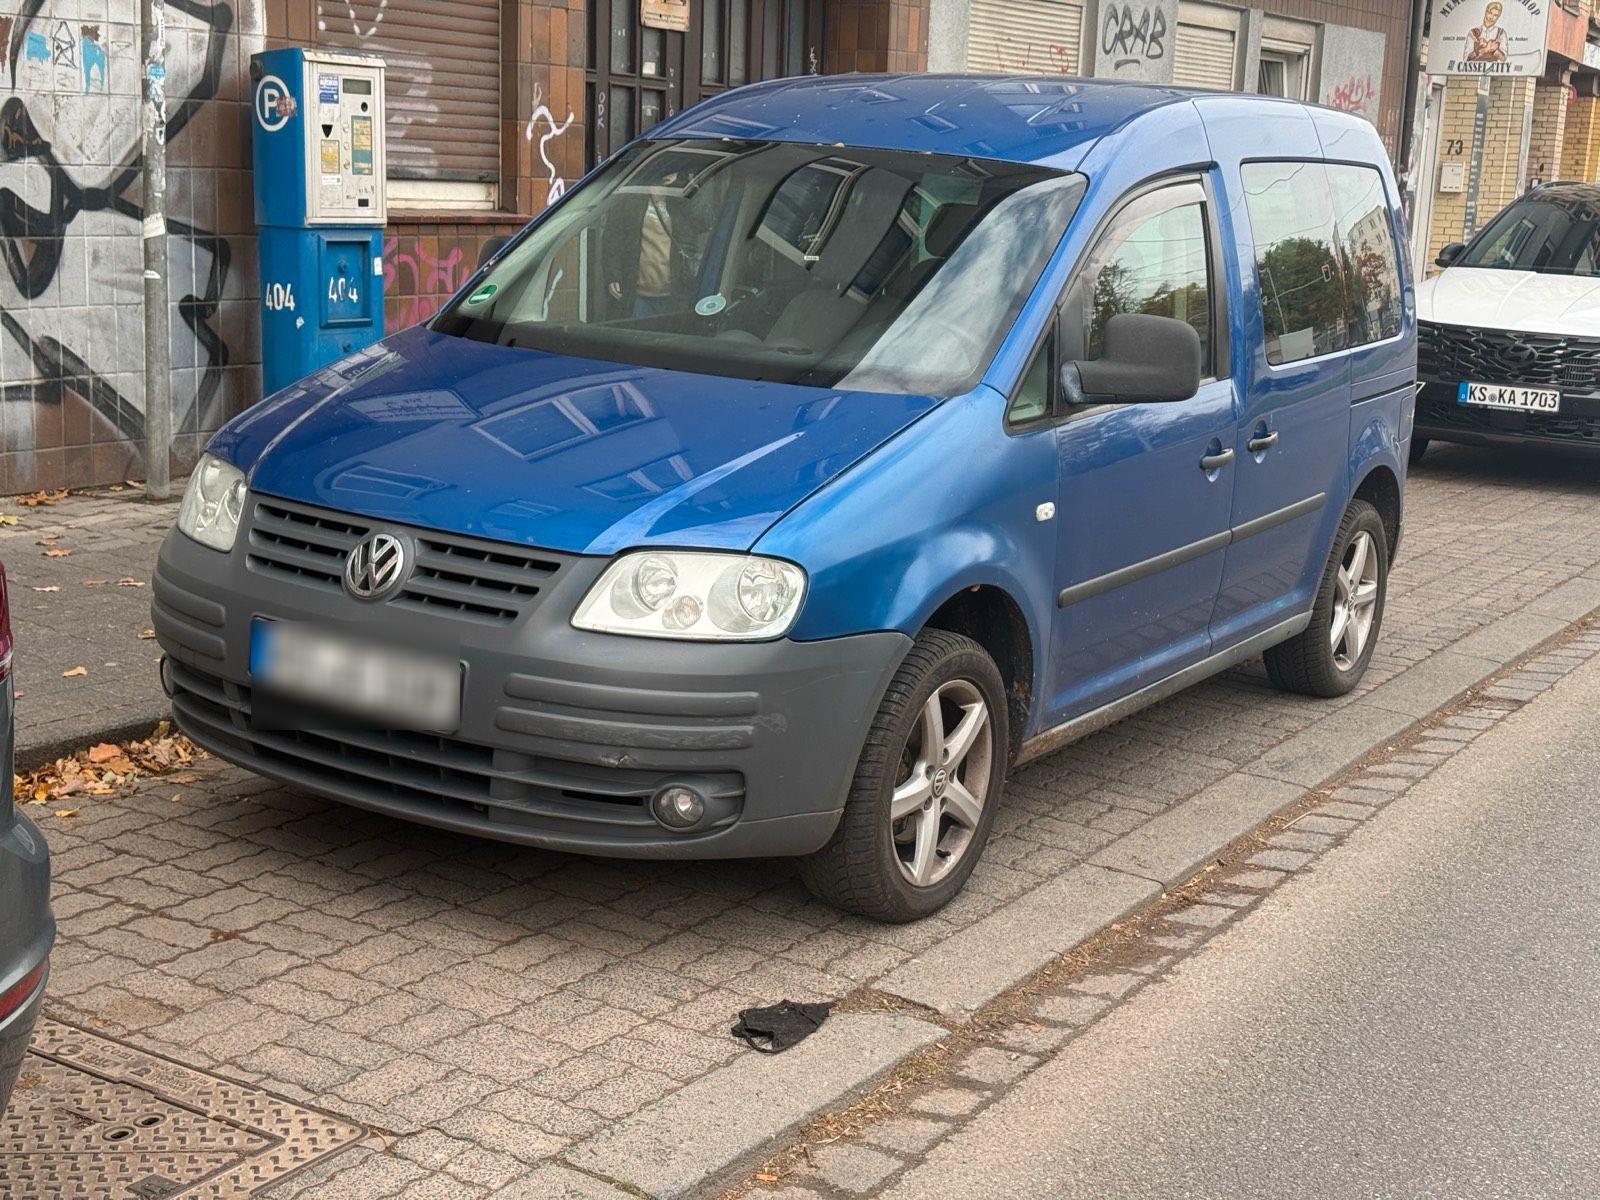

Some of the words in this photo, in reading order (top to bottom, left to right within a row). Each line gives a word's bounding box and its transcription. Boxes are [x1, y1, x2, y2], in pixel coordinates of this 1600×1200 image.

[1102, 4, 1167, 60] CRAB
[1491, 62, 1512, 73] CITY
[1446, 139, 1464, 156] 73
[266, 283, 296, 311] 404
[1469, 385, 1488, 402] KS
[1498, 388, 1516, 405] KA
[1520, 390, 1558, 409] 1703
